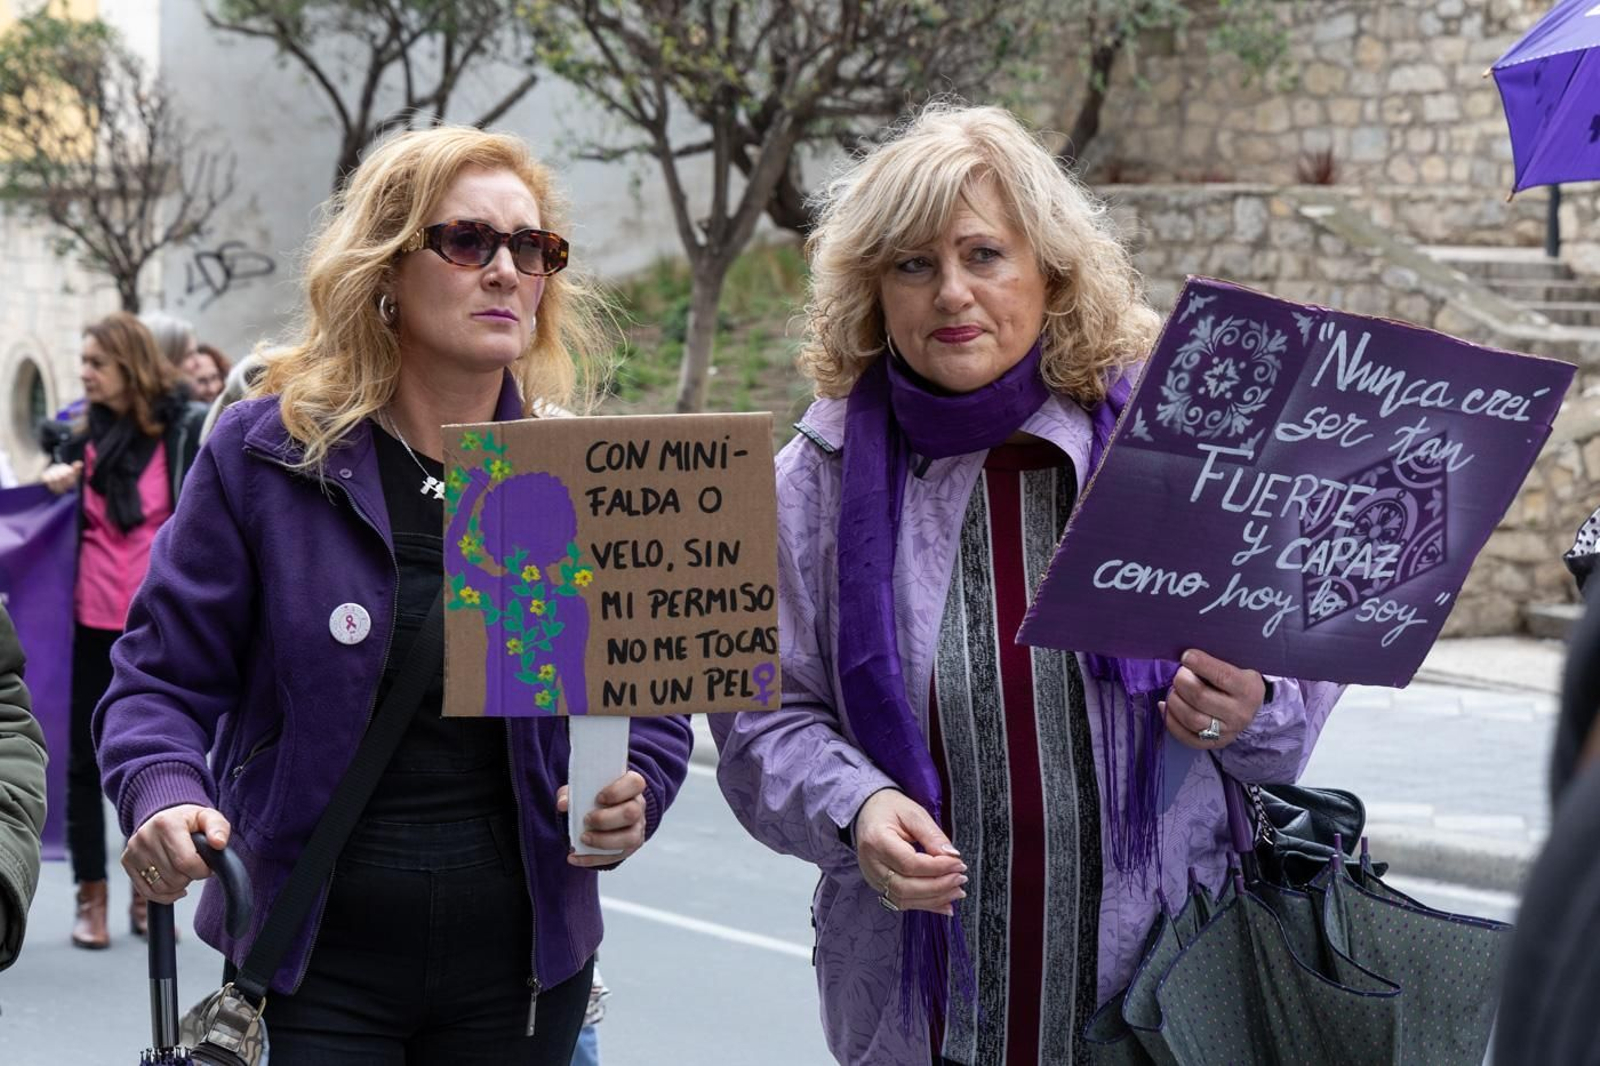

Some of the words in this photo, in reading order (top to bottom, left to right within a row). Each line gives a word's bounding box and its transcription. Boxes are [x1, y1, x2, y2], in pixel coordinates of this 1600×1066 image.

[1461, 387, 1550, 422] creí
[585, 440, 650, 473] CON
[1274, 407, 1374, 448] ser
[1387, 417, 1475, 472] tan
[584, 486, 681, 517] FALDA
[698, 486, 722, 513] O
[1190, 443, 1376, 529] FUERTE
[590, 539, 675, 572] VELO,
[684, 538, 741, 568] SIN
[1276, 536, 1401, 580] CAPAZ
[601, 590, 634, 621] MI
[646, 582, 775, 619] PERMISO
[1093, 558, 1210, 597] como
[1199, 571, 1300, 637] hoy
[1307, 580, 1349, 613] lo
[607, 638, 647, 665] NO
[653, 636, 687, 661] ME
[695, 626, 778, 659] TOCAS
[602, 679, 637, 707] NI
[649, 675, 693, 706] UN
